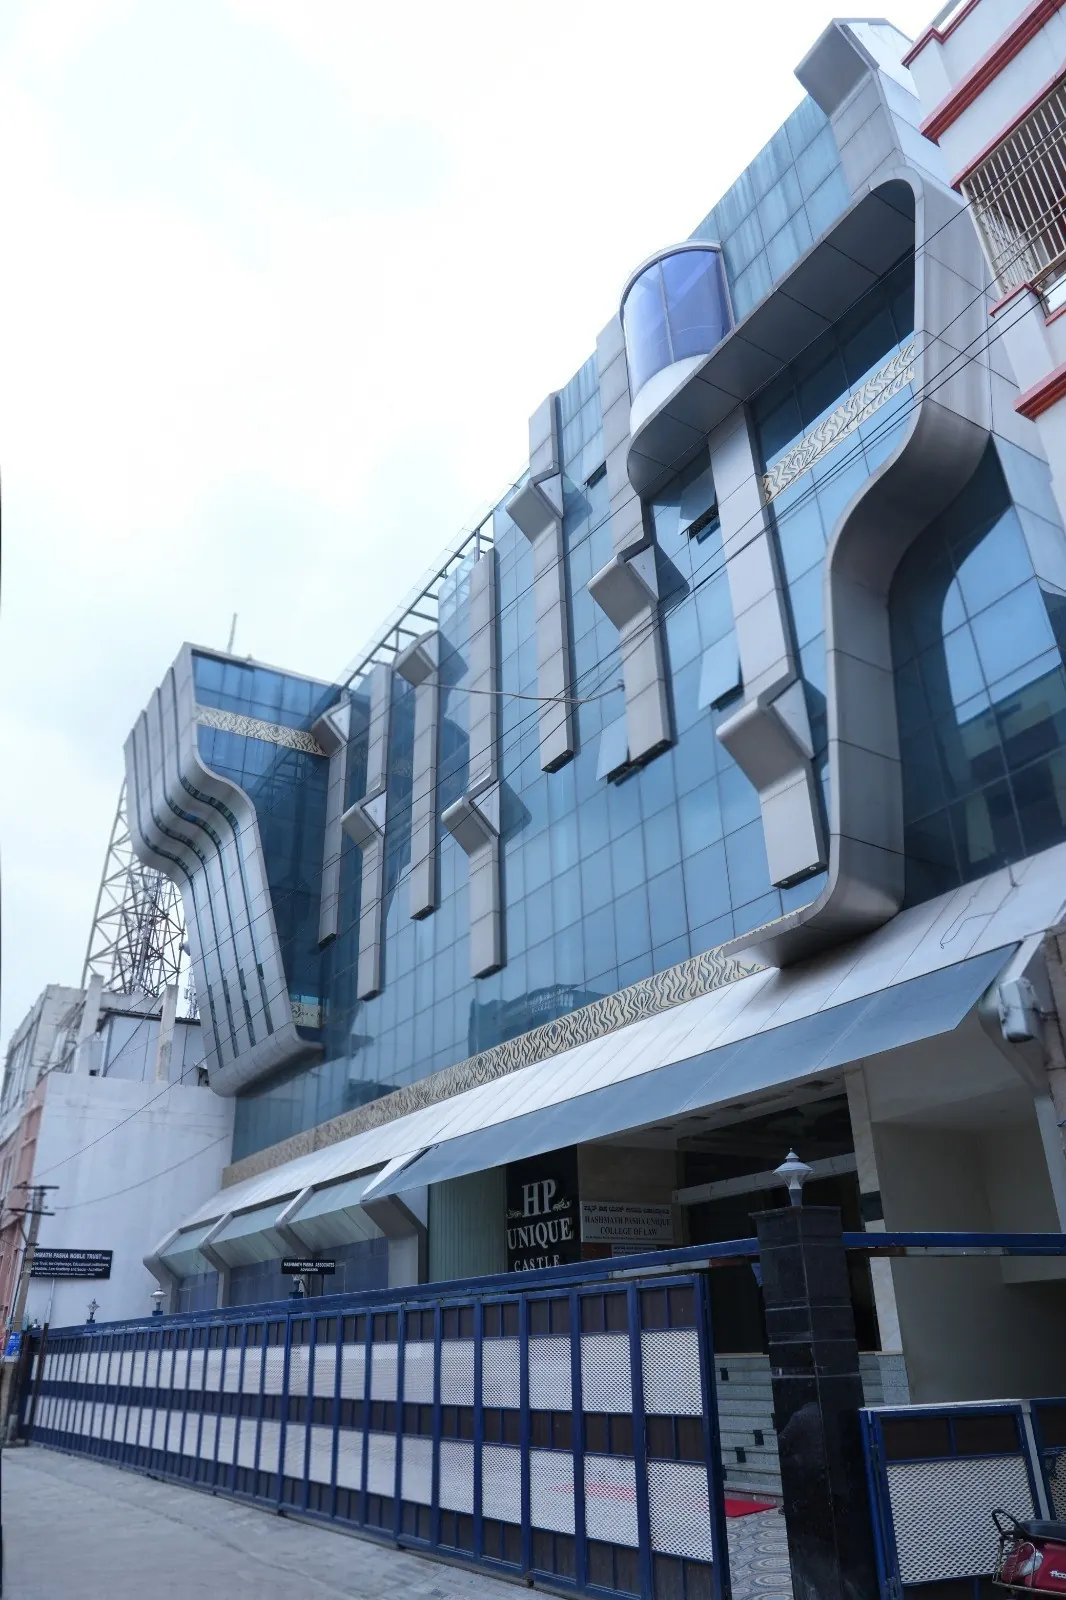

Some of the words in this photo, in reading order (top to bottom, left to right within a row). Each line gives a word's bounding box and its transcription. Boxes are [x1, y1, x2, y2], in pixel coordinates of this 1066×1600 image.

[522, 1179, 557, 1218] HP
[584, 1215, 623, 1225] HASHMATH
[624, 1216, 646, 1226] PASHA
[506, 1218, 573, 1250] UNIQUE
[600, 1226, 632, 1235] COLLEGE
[633, 1227, 642, 1235] OF
[643, 1228, 657, 1236] LAW
[514, 1254, 560, 1273] CASTLE
